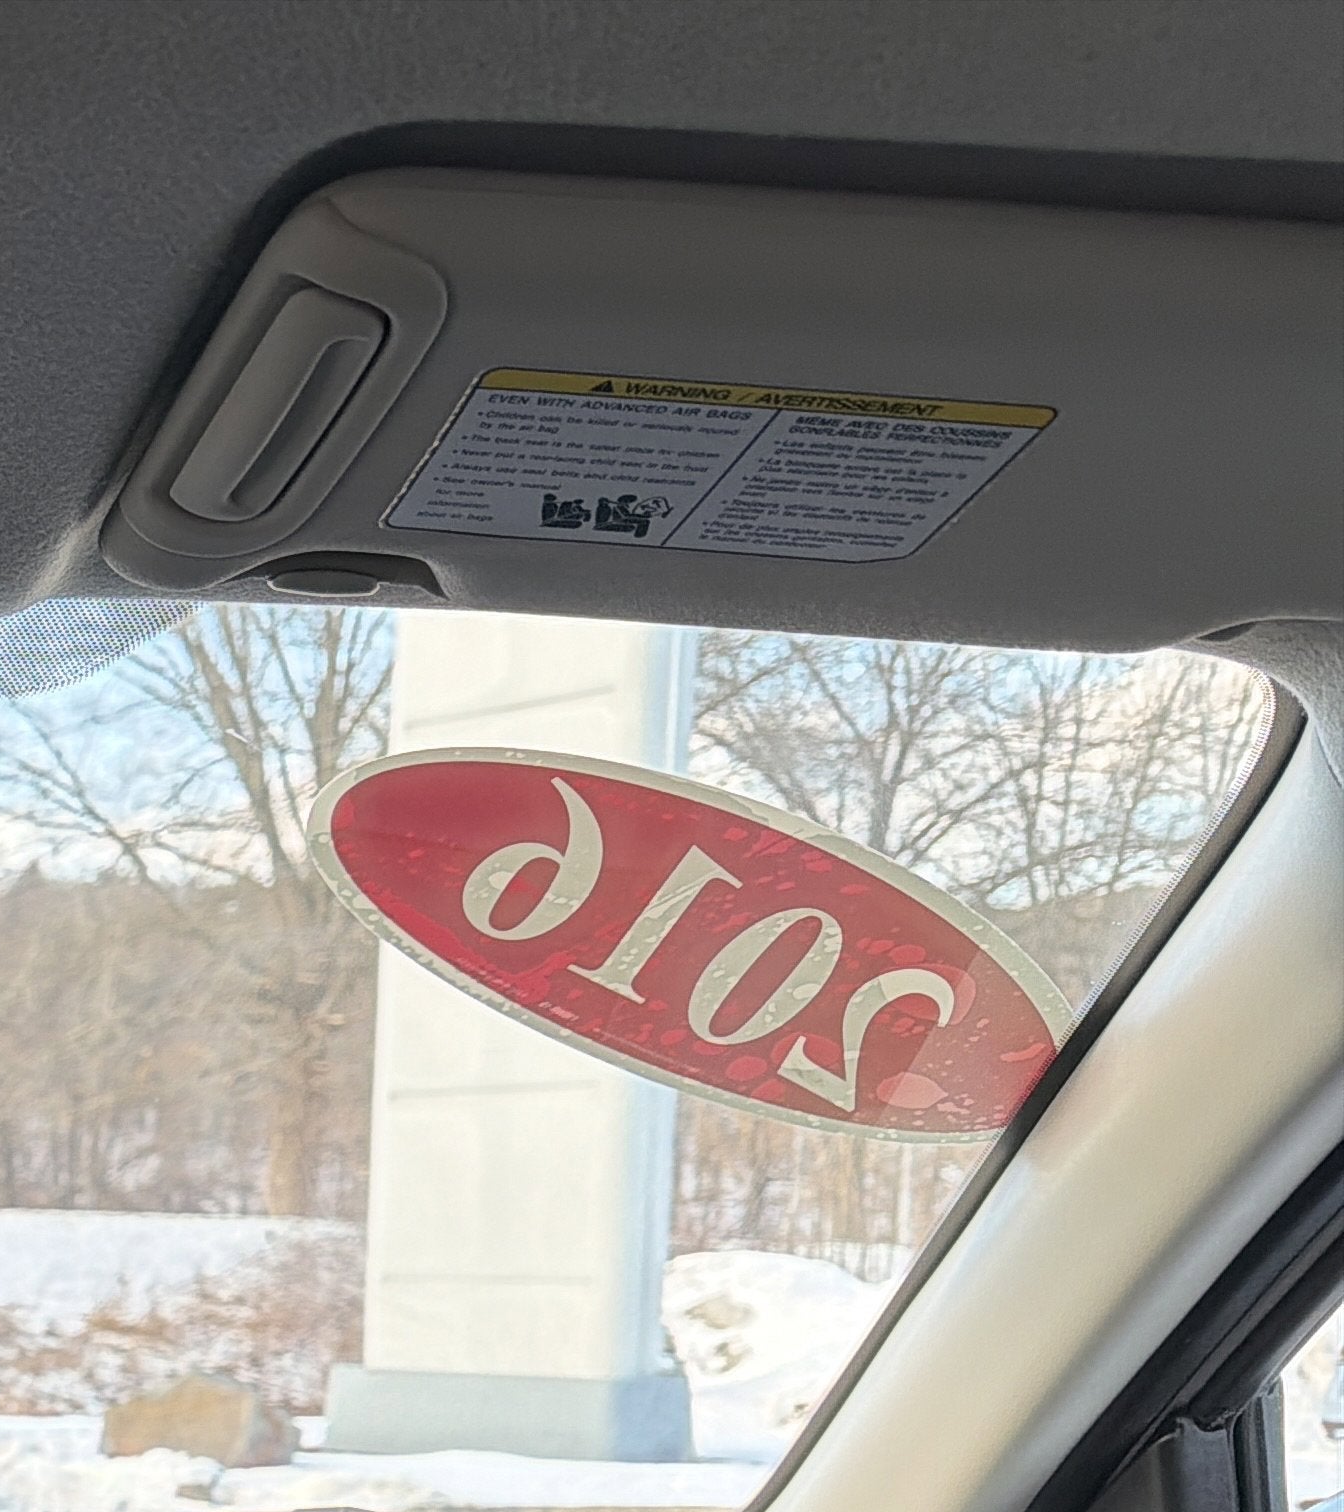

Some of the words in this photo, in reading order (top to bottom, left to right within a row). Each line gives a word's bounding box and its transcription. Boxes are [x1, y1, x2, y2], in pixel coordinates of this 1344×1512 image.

[488, 394, 529, 405] EVEN
[536, 396, 575, 409] WITH
[580, 400, 668, 415] ADVANCED
[672, 407, 701, 417] AIR
[706, 410, 752, 420] BAGS
[625, 382, 732, 401] WARNING
[755, 393, 945, 416] AVERTISSEMENT
